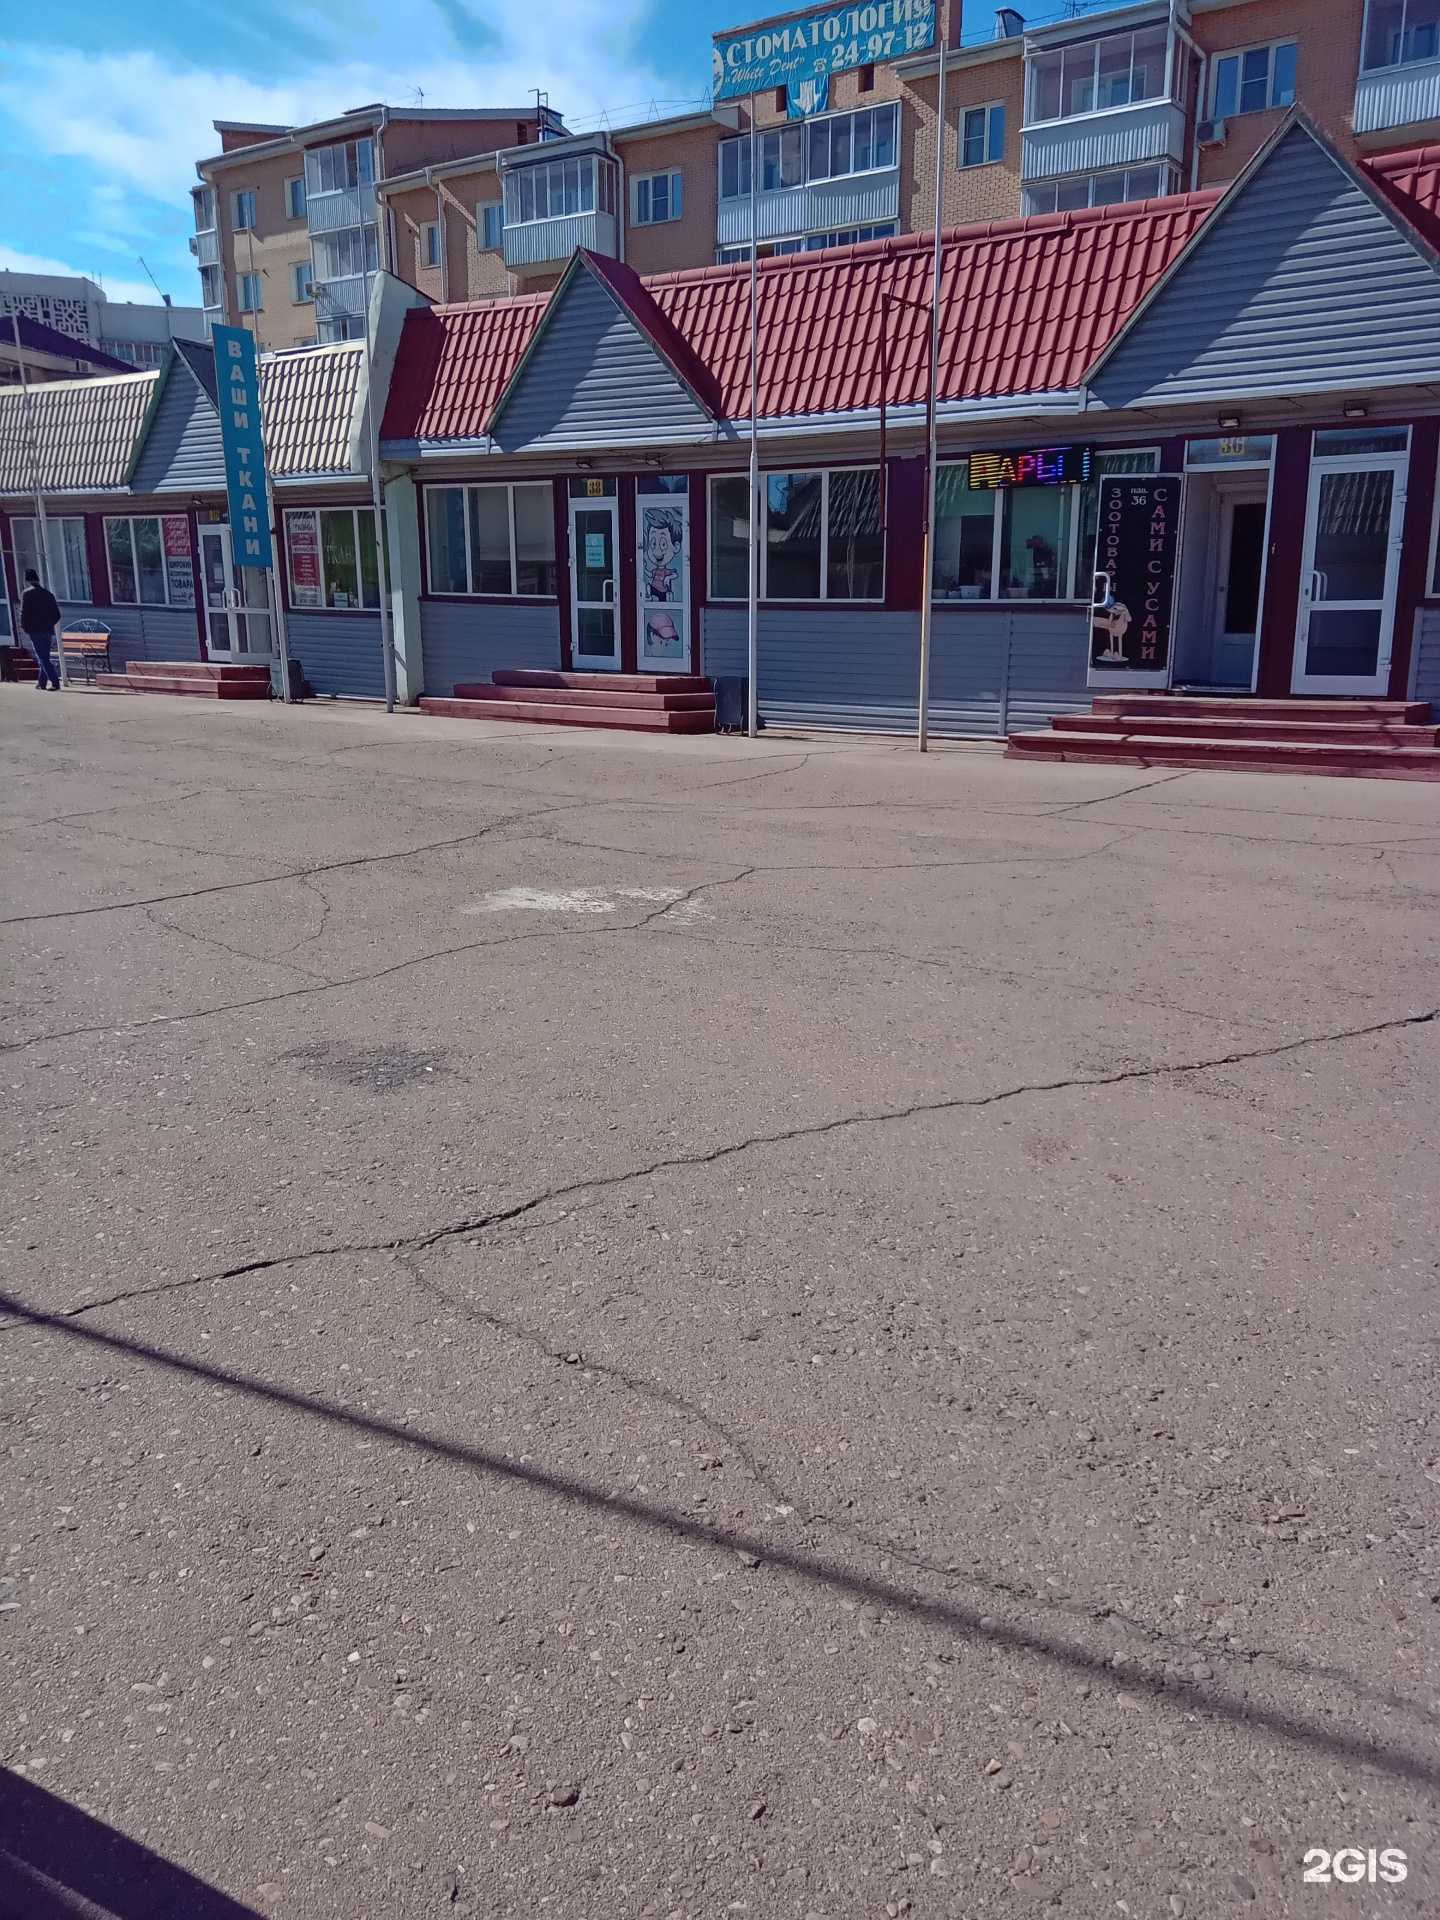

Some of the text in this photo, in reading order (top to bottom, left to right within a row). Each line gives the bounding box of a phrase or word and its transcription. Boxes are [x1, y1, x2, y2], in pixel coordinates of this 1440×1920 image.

[726, 0, 931, 67] СТОМАТОЛОГИЯ
[831, 22, 929, 67] 24-97-12
[227, 340, 261, 555] ВАШИ ТКАНИ
[587, 480, 602, 495] 38
[1130, 496, 1147, 506] 36
[1139, 488, 1168, 660] САМИ С УСАМИ
